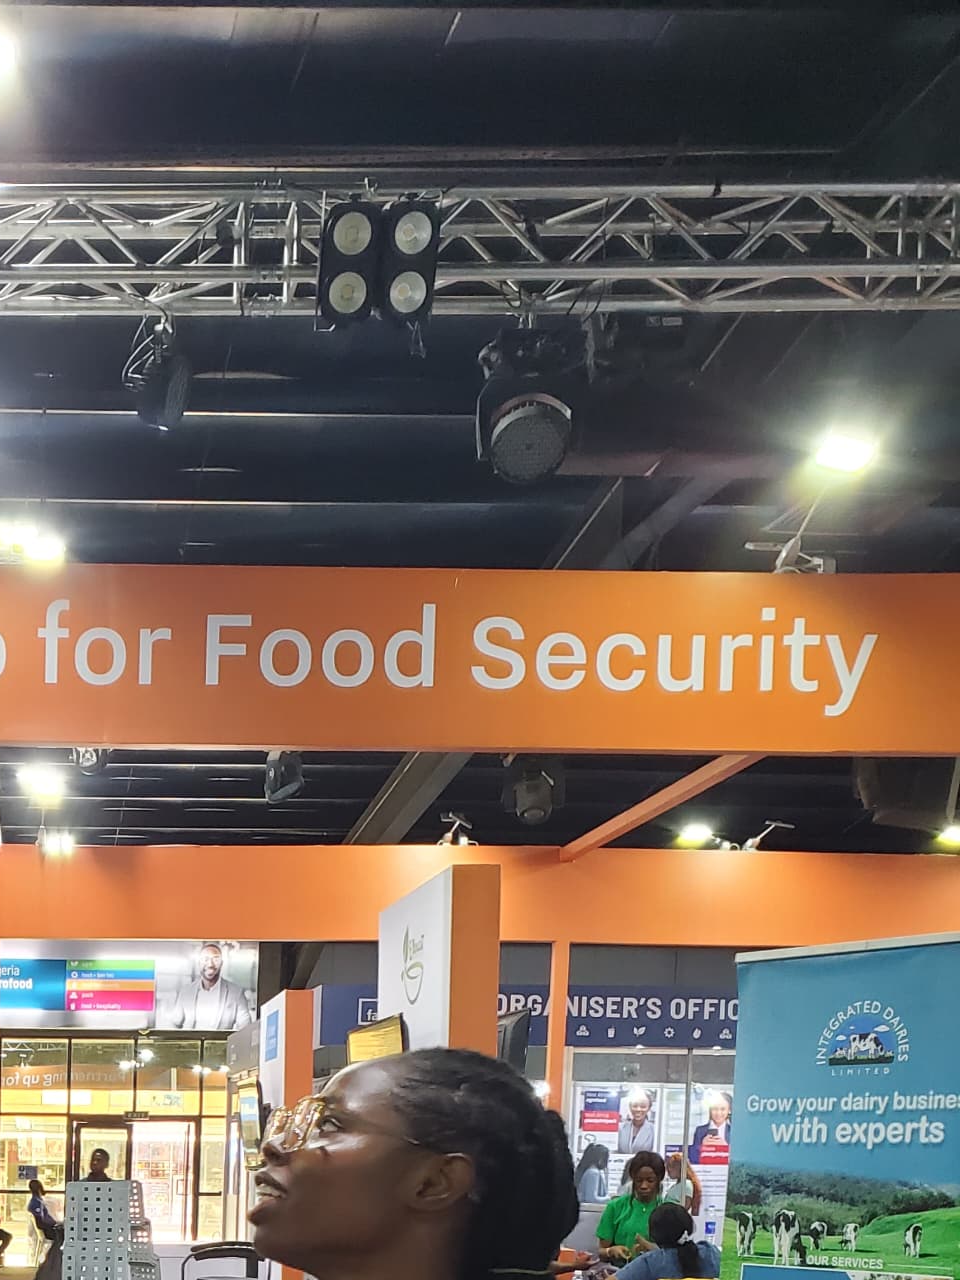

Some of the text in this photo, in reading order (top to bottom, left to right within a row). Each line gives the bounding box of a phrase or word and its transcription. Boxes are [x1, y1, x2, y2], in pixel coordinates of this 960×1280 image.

[37, 599, 172, 686] for
[204, 603, 437, 688] Food
[470, 606, 878, 716] Security
[816, 1000, 909, 1065] INTEGRATED DAIRIES
[831, 1067, 890, 1077] LIMITED
[746, 1094, 793, 1112] Grow
[796, 1095, 837, 1116] your
[840, 1092, 889, 1115] dairy
[771, 1114, 945, 1150] with experts
[806, 1254, 884, 1269] OUR SERVICES
